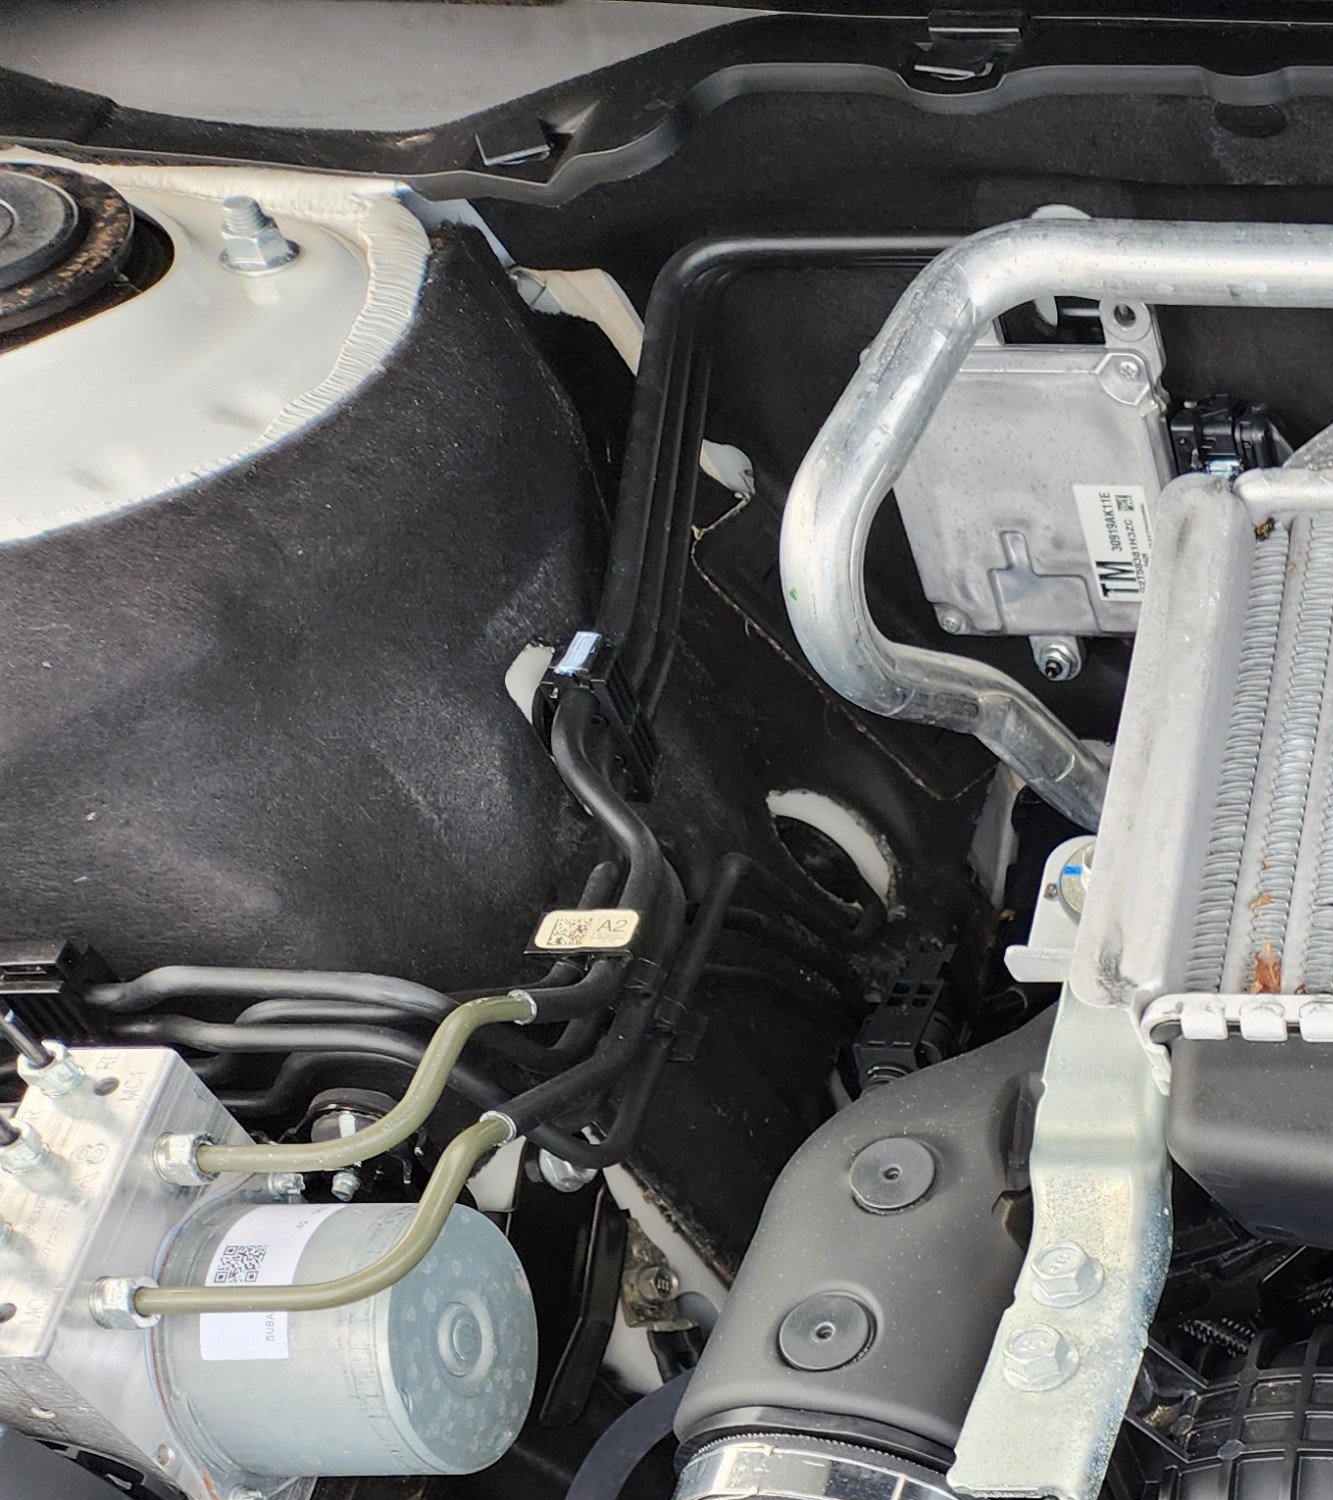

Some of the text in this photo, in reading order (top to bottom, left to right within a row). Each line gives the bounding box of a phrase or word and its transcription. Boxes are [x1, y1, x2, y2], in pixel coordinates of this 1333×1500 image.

[1095, 561, 1140, 597] TM
[597, 919, 628, 932] A2
[265, 1312, 275, 1342] SUBA
